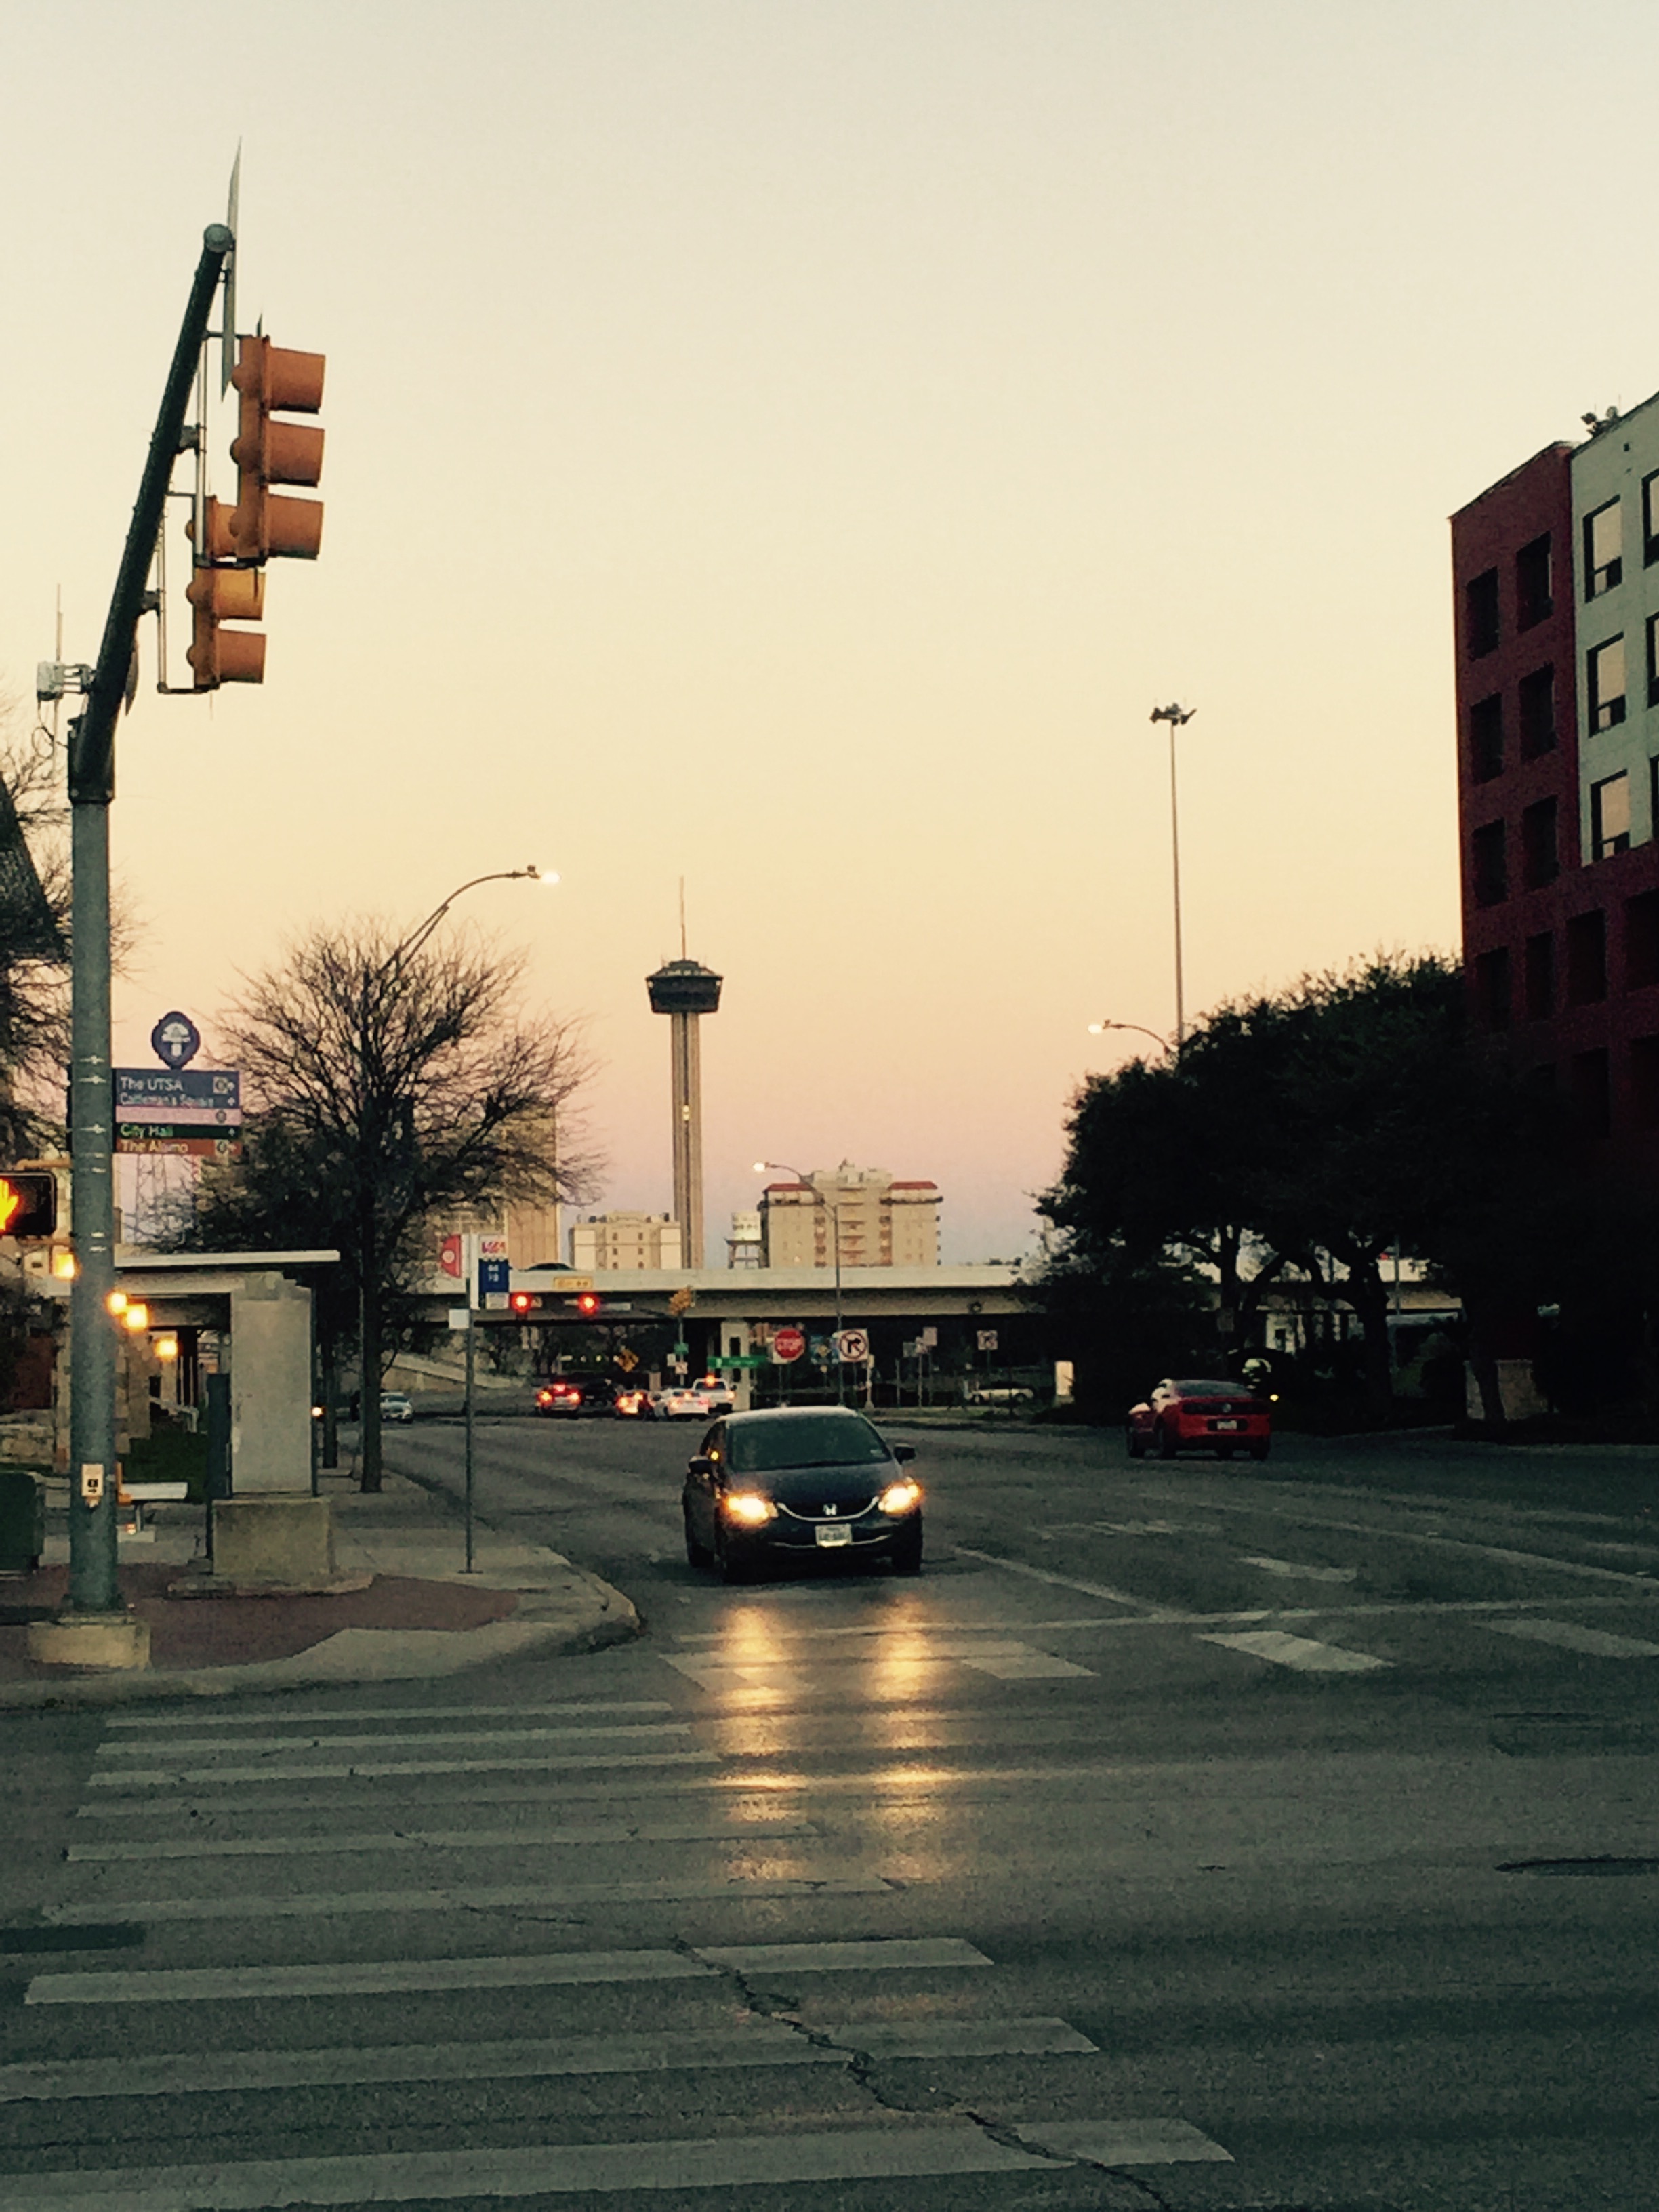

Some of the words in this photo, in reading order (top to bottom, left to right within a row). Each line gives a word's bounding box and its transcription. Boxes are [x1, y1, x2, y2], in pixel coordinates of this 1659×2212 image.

[120, 1076, 144, 1090] The
[147, 1078, 184, 1092] UTSA
[121, 1139, 146, 1151] The
[776, 1338, 803, 1351] STOP
